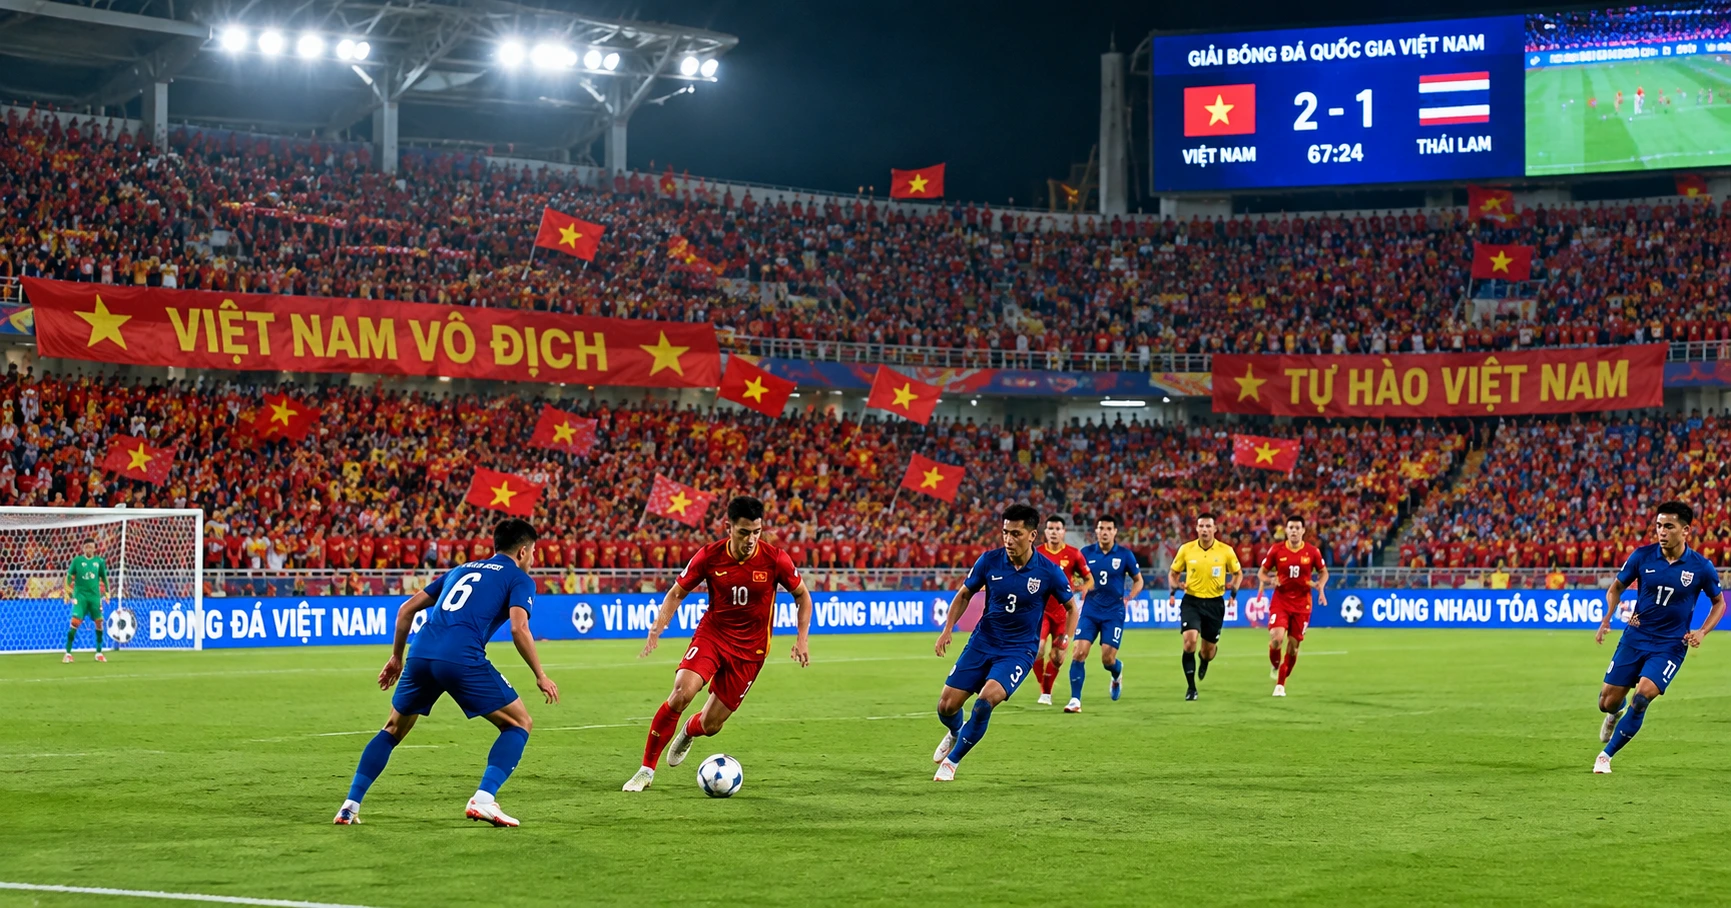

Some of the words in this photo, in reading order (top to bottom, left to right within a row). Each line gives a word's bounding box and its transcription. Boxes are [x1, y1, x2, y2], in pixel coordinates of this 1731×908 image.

[1189, 45, 1222, 66] GIẢI
[1228, 44, 1276, 64] BÓNG
[1311, 37, 1360, 61] QUỐC
[1365, 40, 1395, 57] GIA
[1400, 34, 1439, 58] VIỆT
[1443, 34, 1484, 52] NAM
[1294, 92, 1317, 130] 2
[1356, 89, 1372, 127] 1
[1183, 145, 1217, 167] VIỆT
[1221, 147, 1255, 162] NAM
[1308, 144, 1363, 163] 67:24
[1417, 134, 1453, 154] THÁI
[1459, 136, 1491, 152] LAM
[166, 300, 274, 364] VIỆT
[291, 314, 397, 359] NAM
[409, 312, 475, 363] VÔ
[490, 325, 607, 377] ĐỊCH
[1285, 364, 1337, 412] TỰ
[1349, 359, 1428, 405] HÀO
[1442, 357, 1527, 411] VIỆT
[1541, 360, 1628, 401] NAM
[1099, 570, 1108, 586] 3
[1289, 565, 1300, 578] 19
[441, 572, 482, 611] 6
[731, 585, 748, 606] 10
[1005, 593, 1017, 613] 3
[1655, 585, 1675, 607] 17
[871, 602, 923, 629] MẠNH
[1435, 599, 1491, 621] NHAU
[1497, 593, 1538, 622] TÓA
[1544, 593, 1602, 623] SÁNG
[230, 602, 266, 638] ĐÁ
[273, 601, 325, 643] VIỆT
[333, 608, 386, 636] NAM
